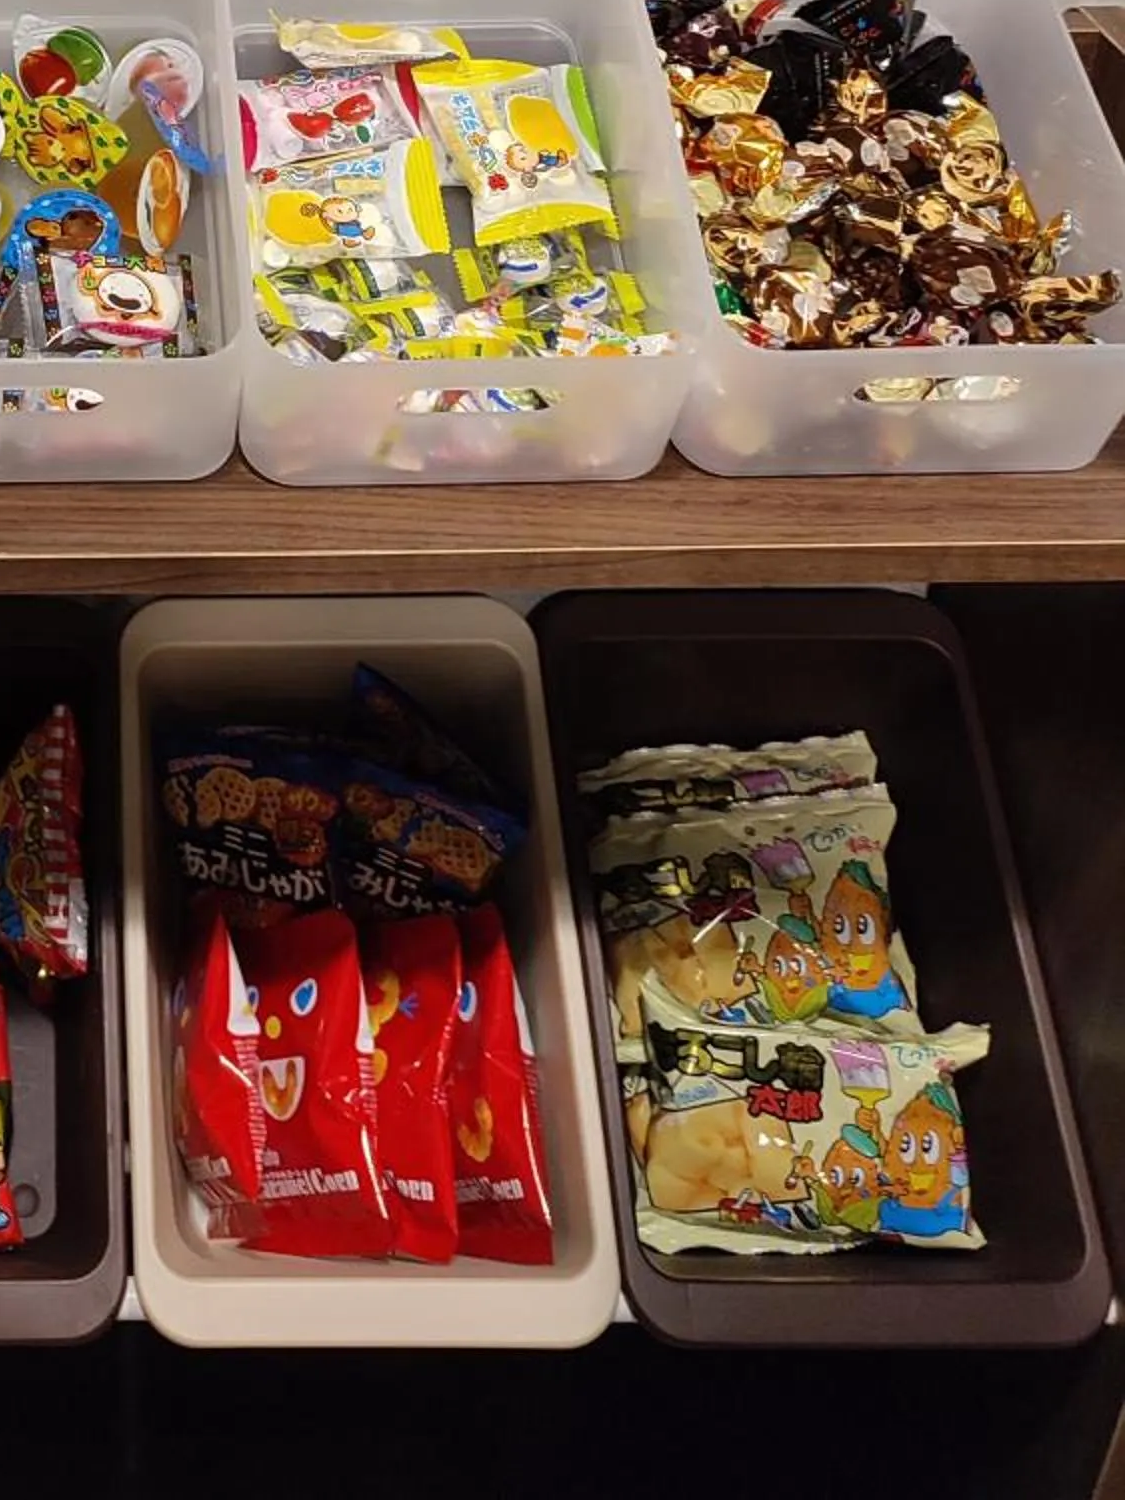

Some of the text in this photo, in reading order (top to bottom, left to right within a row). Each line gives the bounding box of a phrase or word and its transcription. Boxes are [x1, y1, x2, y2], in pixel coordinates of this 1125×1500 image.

[224, 825, 269, 858] ミニ
[182, 840, 327, 902] あみじゃが
